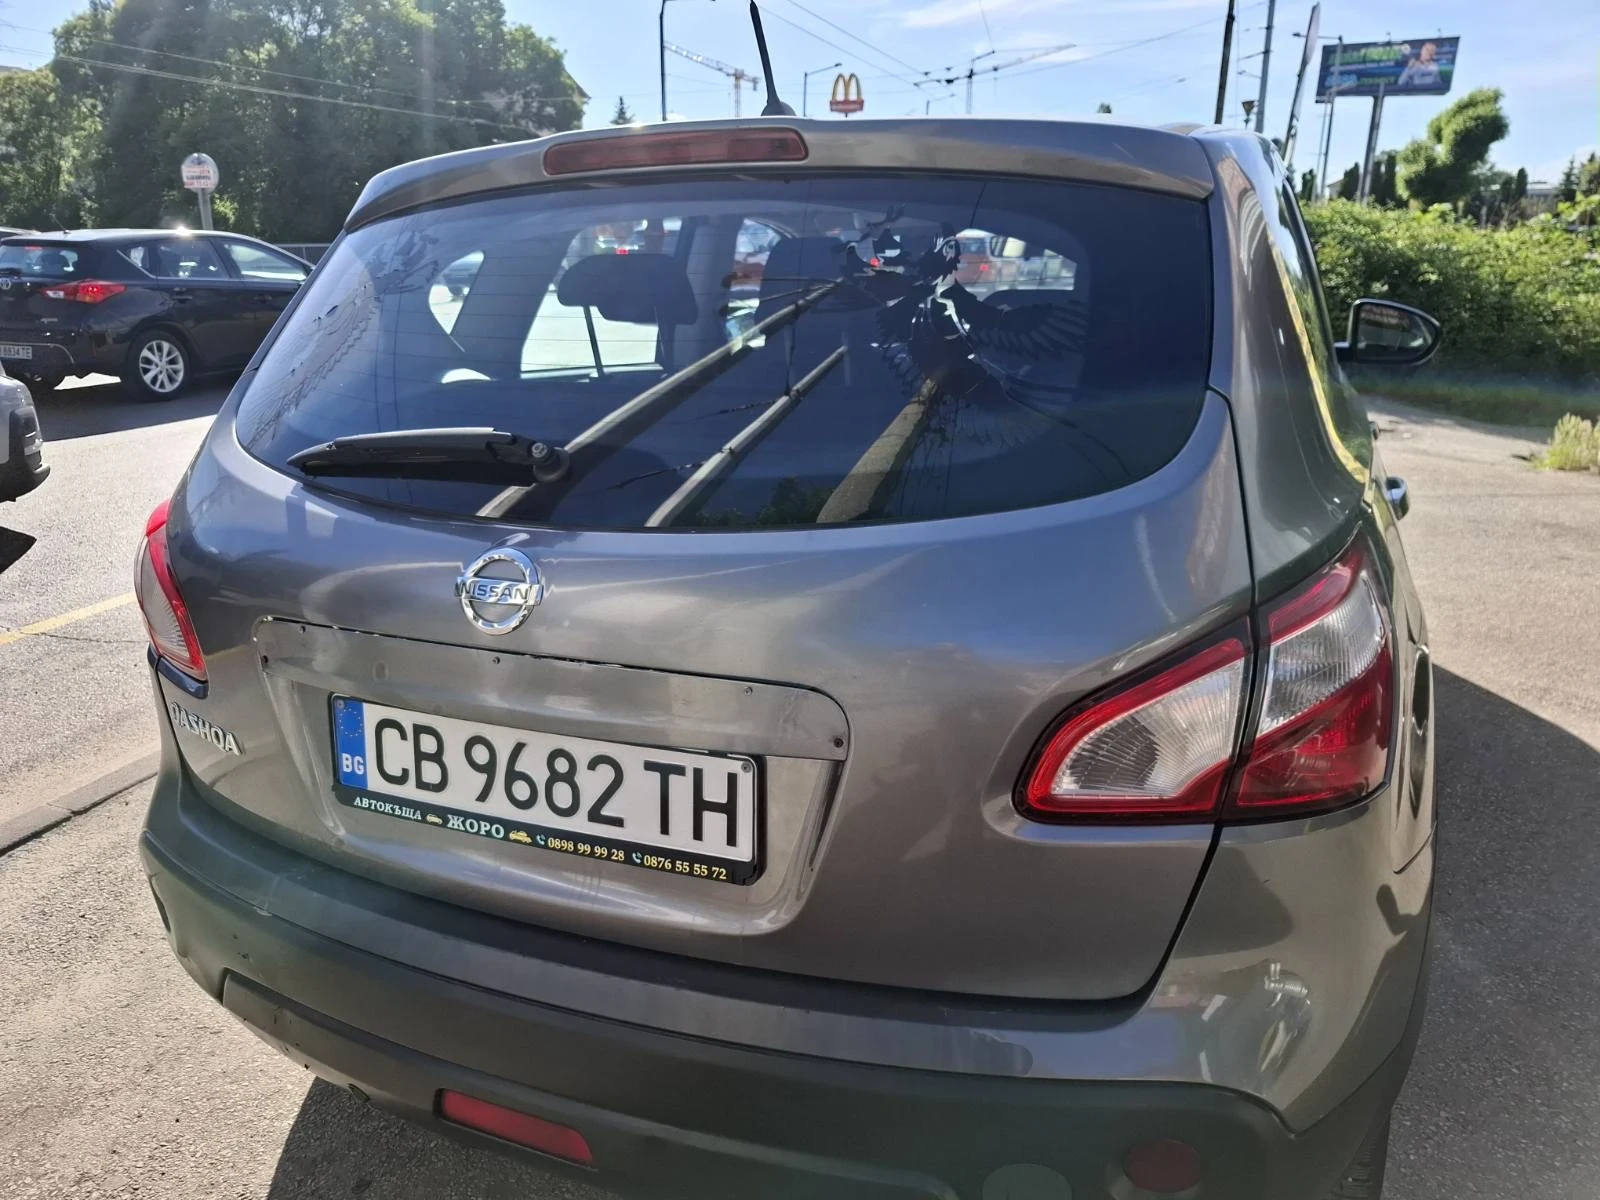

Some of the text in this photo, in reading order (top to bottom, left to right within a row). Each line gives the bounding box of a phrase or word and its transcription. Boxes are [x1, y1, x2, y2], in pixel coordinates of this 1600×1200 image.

[455, 583, 529, 600] NISSAN
[342, 753, 365, 775] BG
[374, 718, 738, 847] CB 9682 TH
[353, 796, 505, 839] АВТОКЪЩА ЖОРО
[548, 837, 625, 861] 0898 99 99 28
[643, 855, 727, 880] 0876 55 55 72
